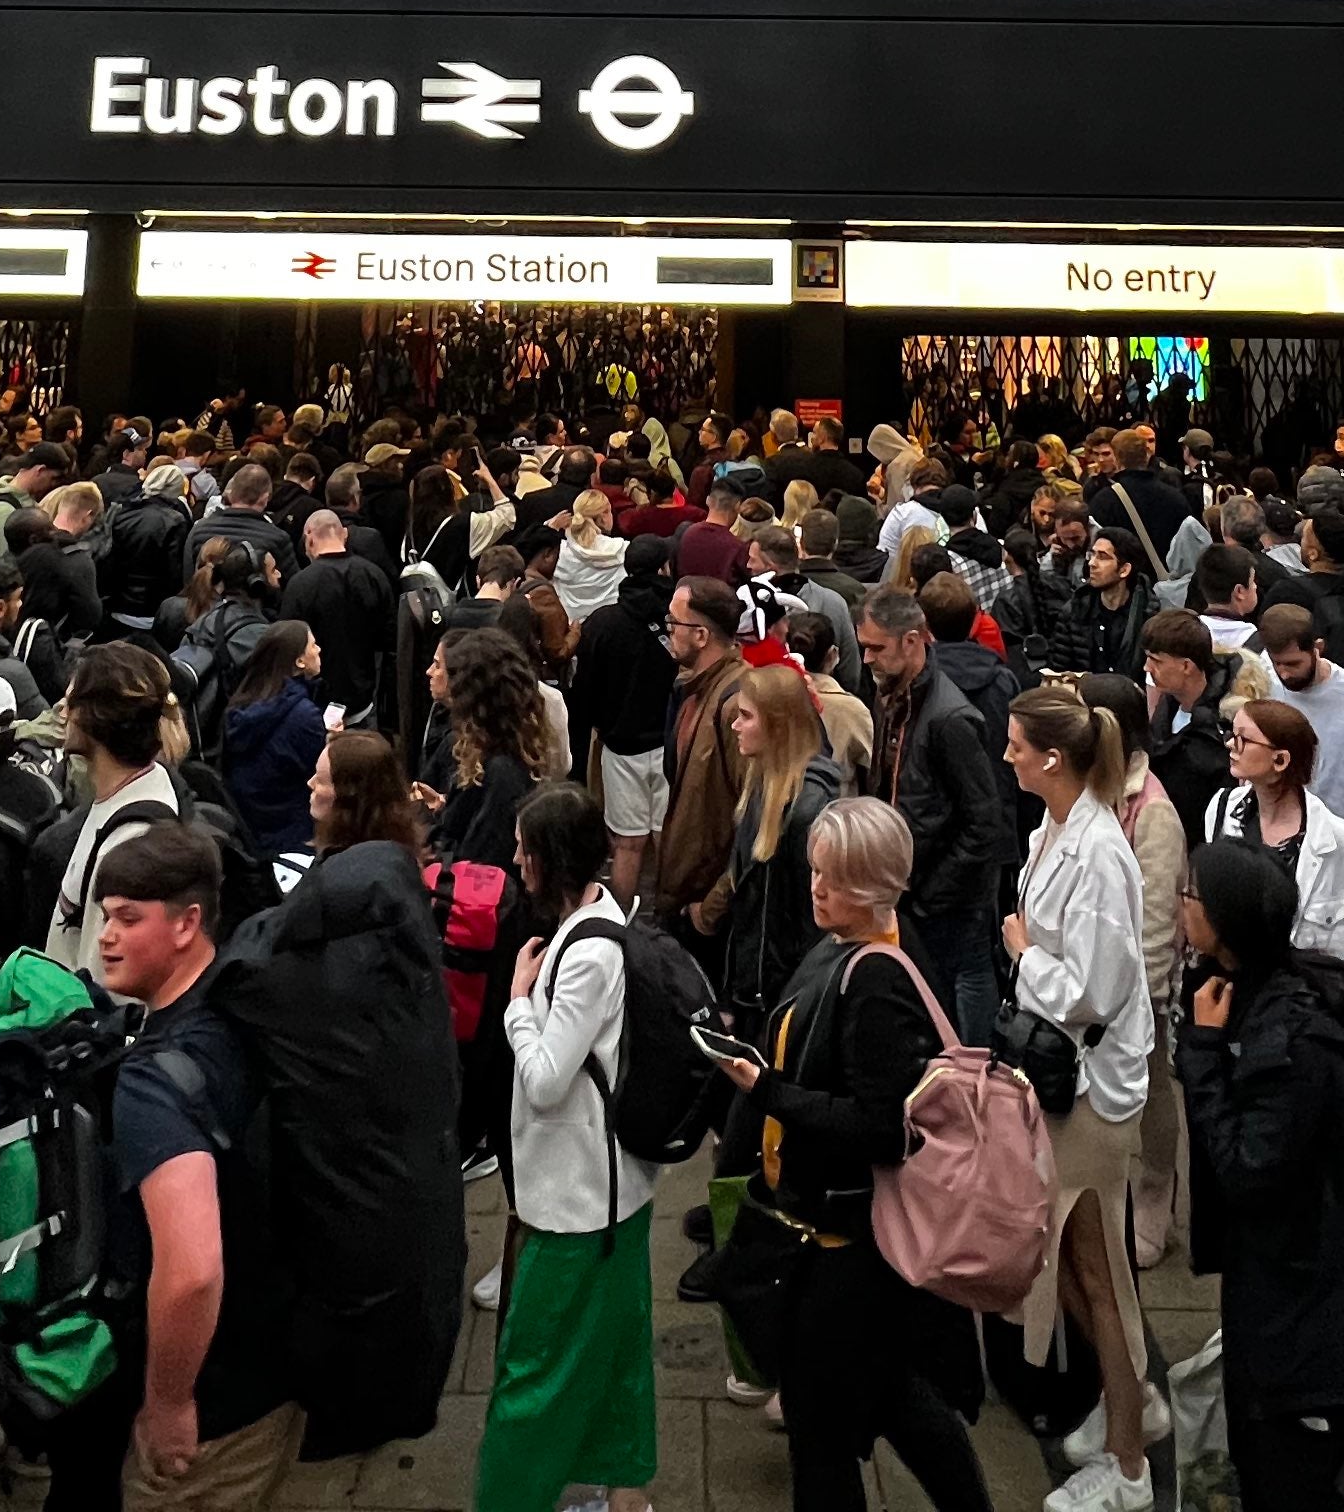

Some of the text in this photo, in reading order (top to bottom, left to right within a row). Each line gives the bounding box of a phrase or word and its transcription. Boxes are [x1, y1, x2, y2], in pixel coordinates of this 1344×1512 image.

[89, 56, 398, 137] Euston
[357, 251, 608, 284] Euston Station
[1067, 263, 1216, 300] No entry
